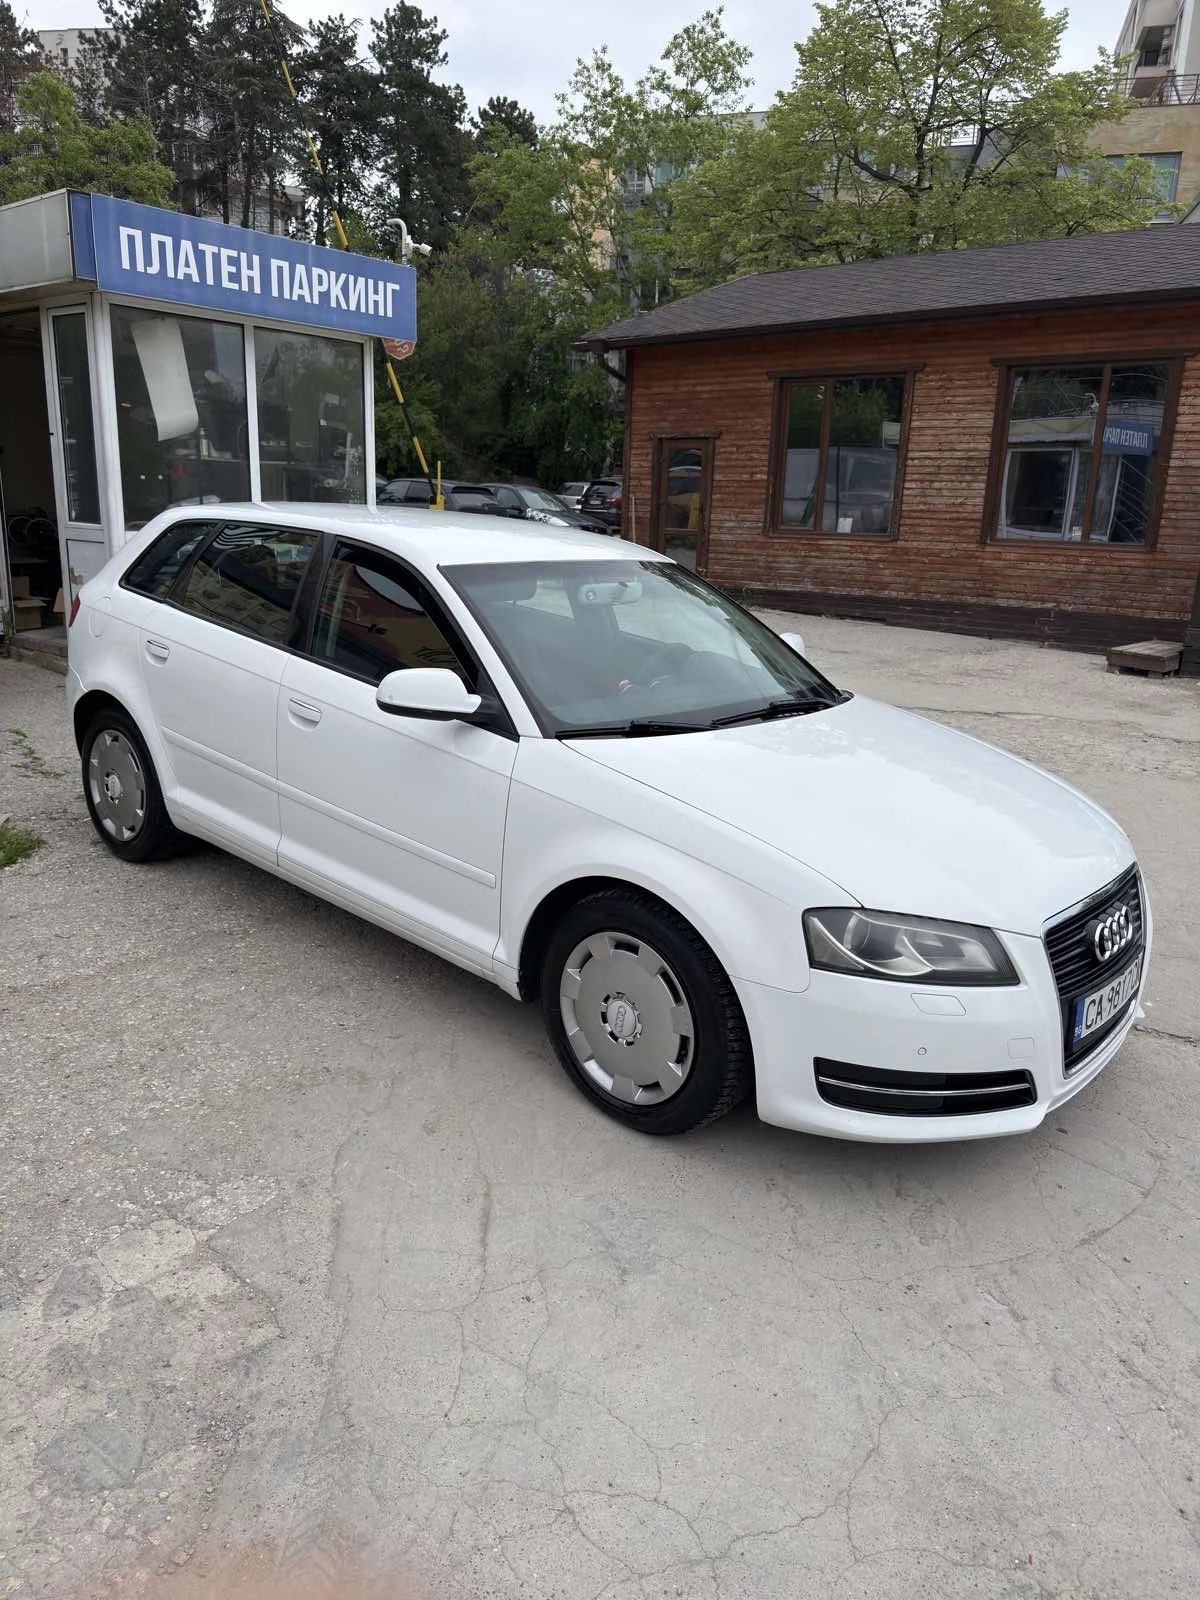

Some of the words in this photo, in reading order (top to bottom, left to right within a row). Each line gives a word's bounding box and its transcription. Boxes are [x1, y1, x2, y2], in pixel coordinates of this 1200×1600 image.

[119, 225, 261, 294] ПЛАТЕН
[270, 258, 400, 318] ПАРКИНГ
[1085, 994, 1103, 1030] CA
[1107, 970, 1133, 1015] 9817
